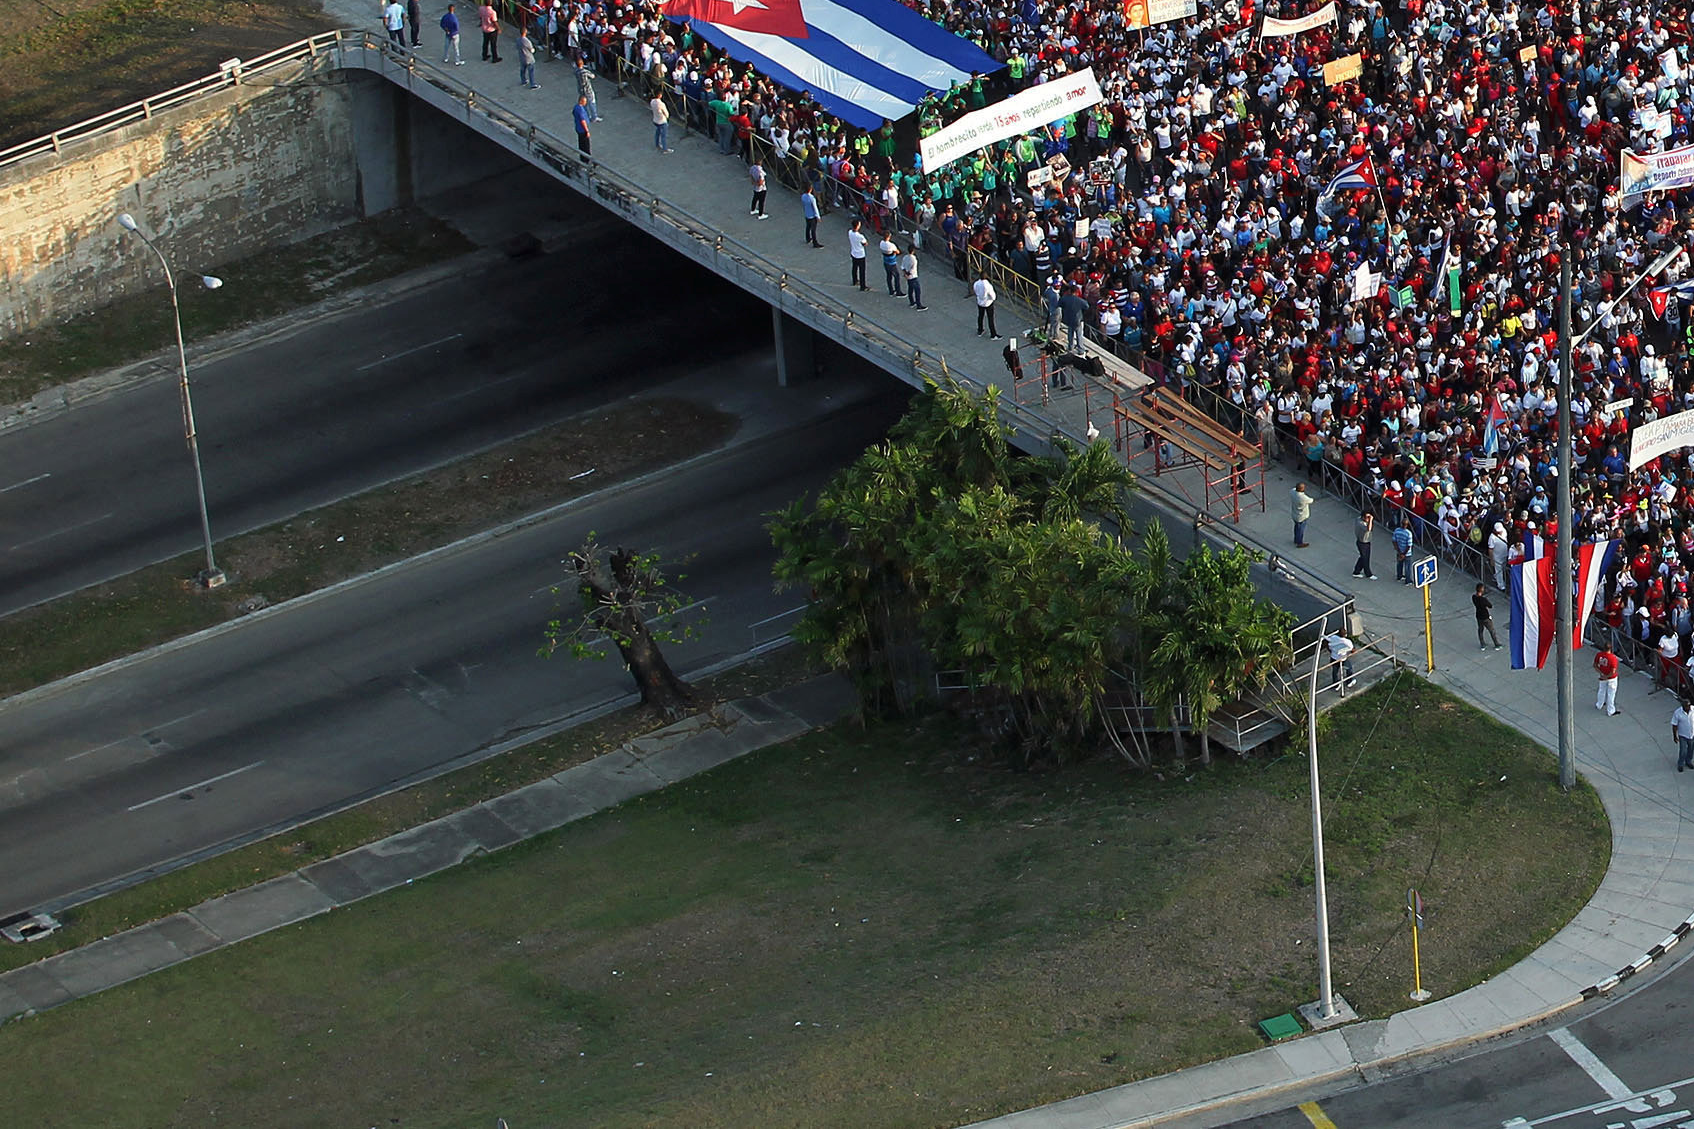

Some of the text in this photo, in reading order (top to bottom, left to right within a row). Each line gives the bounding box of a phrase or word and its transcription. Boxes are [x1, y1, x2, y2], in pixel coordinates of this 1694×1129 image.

[936, 128, 977, 154] hombrecito
[994, 116, 1004, 128] 15
[1004, 112, 1021, 126] años
[1022, 94, 1063, 119] repartiendo
[1066, 86, 1087, 101] amor
